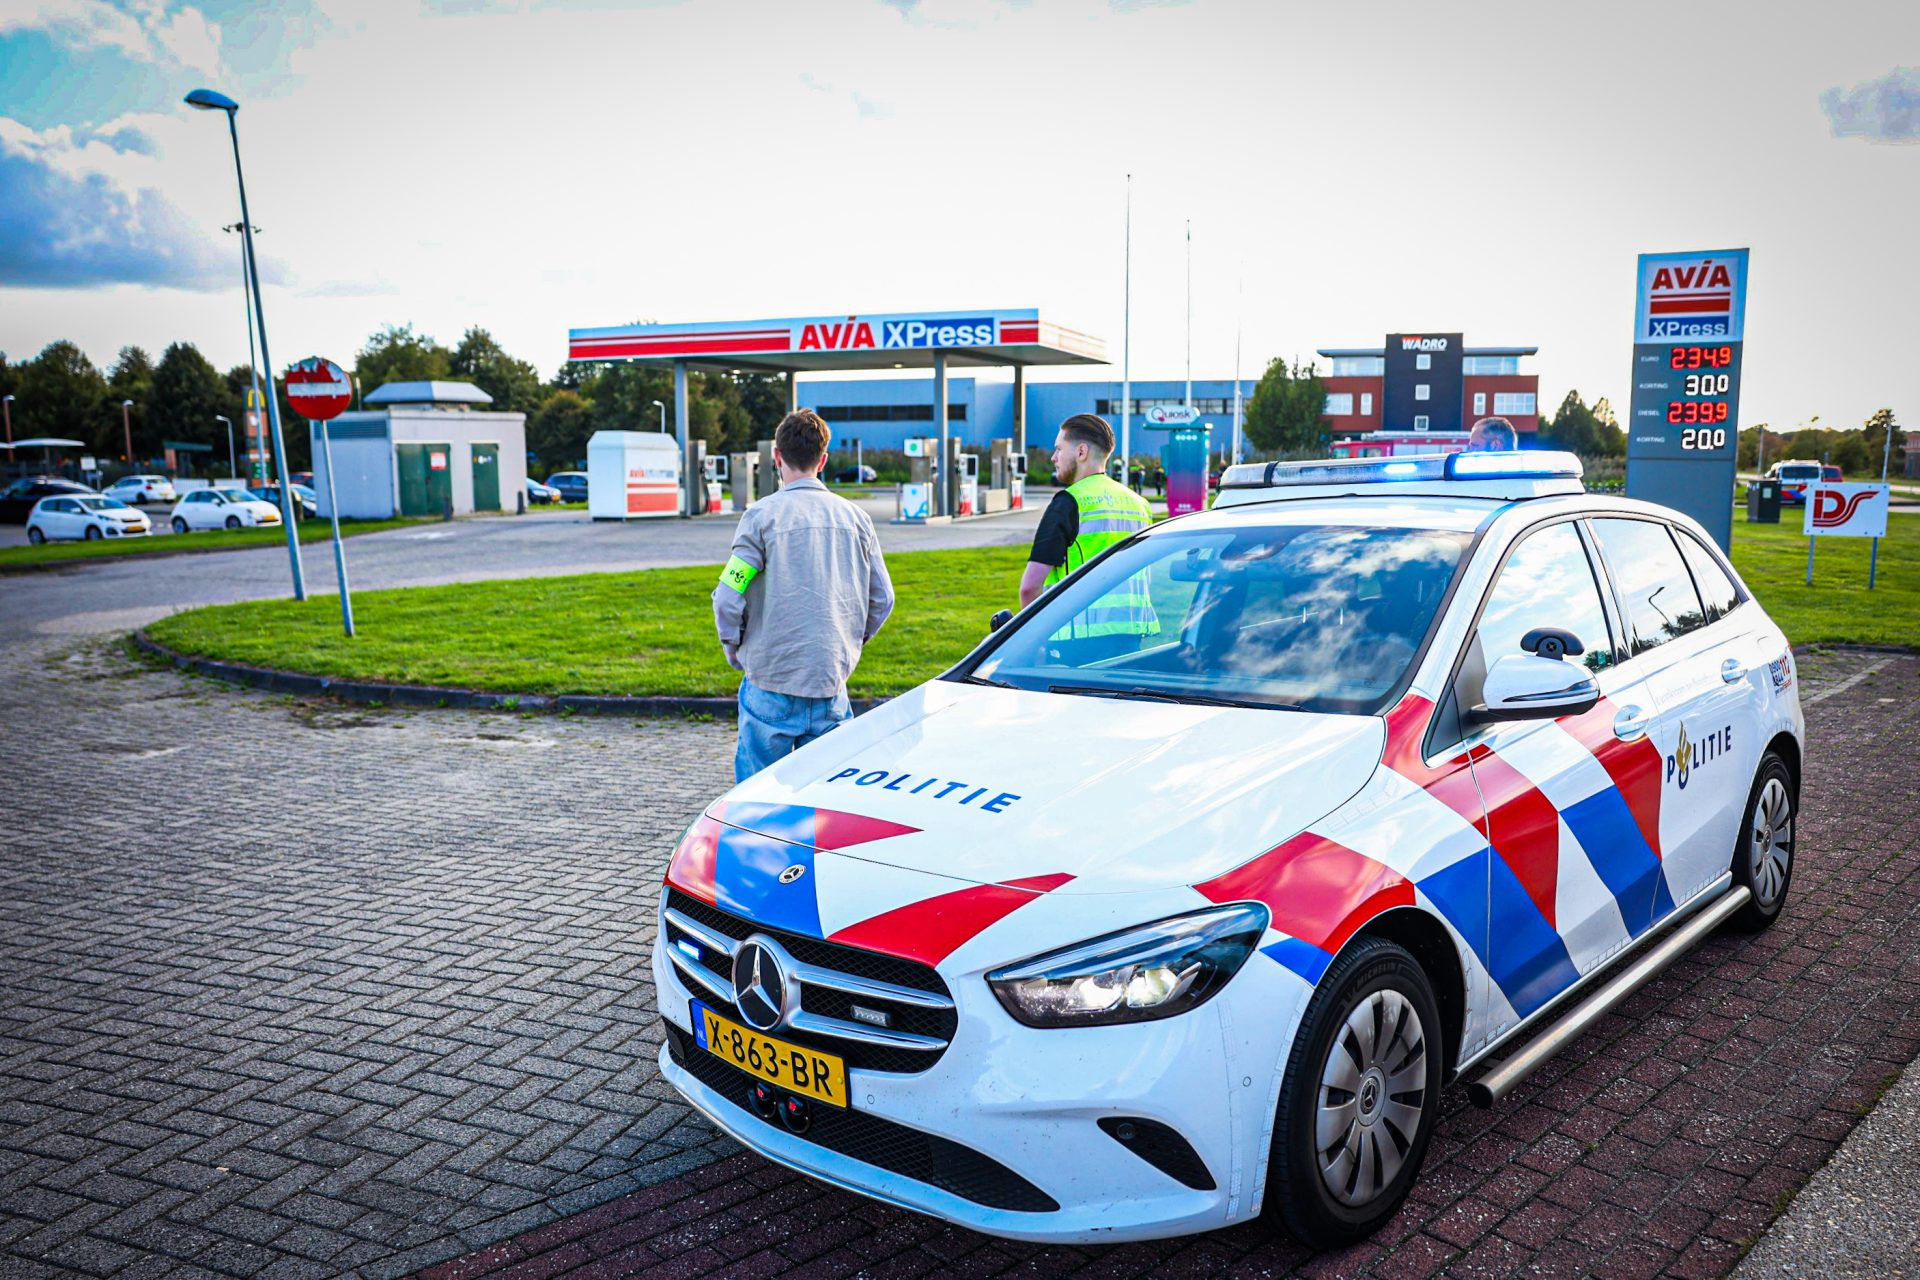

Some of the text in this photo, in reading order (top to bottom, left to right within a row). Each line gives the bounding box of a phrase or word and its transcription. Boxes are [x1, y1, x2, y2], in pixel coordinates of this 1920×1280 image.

[884, 321, 993, 348] XPress
[1402, 337, 1447, 350] WADRO
[1652, 321, 1726, 337] XPress
[1667, 725, 1731, 790] POLITIE
[826, 767, 1022, 814] POLITIE
[708, 1016, 833, 1097] X-863-BR
